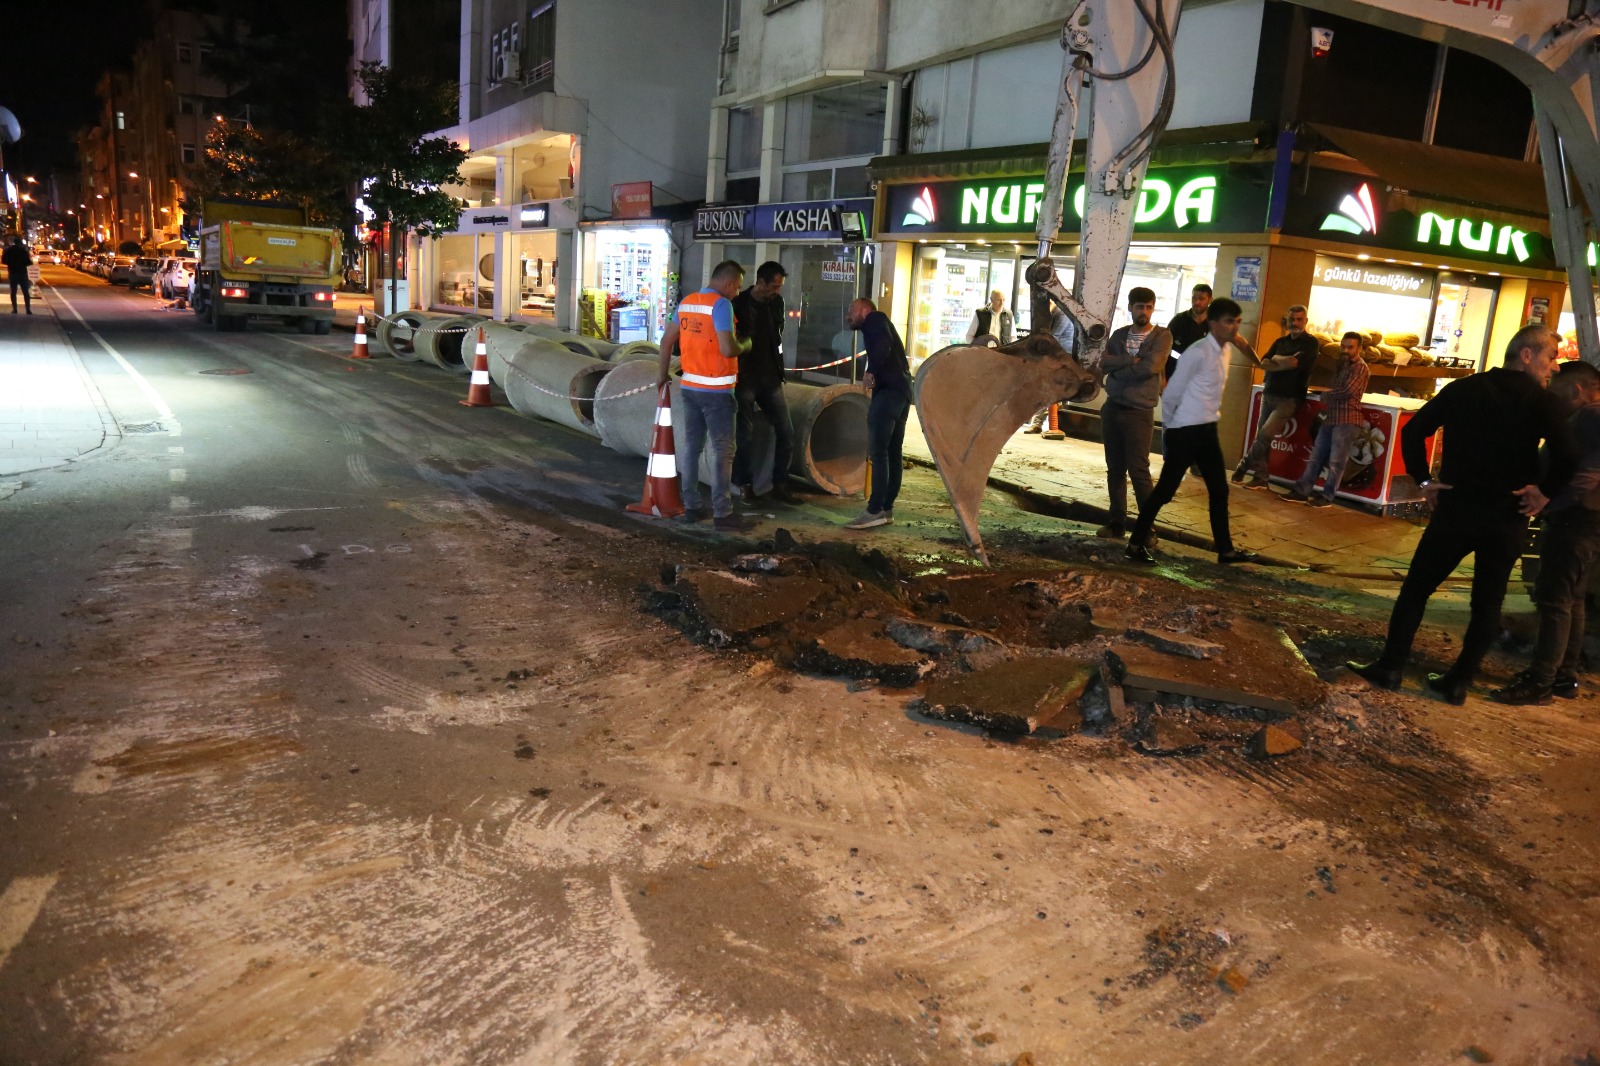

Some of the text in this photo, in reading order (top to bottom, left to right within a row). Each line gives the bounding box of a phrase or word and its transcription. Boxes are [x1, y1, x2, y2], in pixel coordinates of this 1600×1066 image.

[697, 210, 744, 231] FUSION
[773, 208, 832, 232] KASHA
[1323, 266, 1361, 283] günkü
[1270, 439, 1294, 453] GIDA
